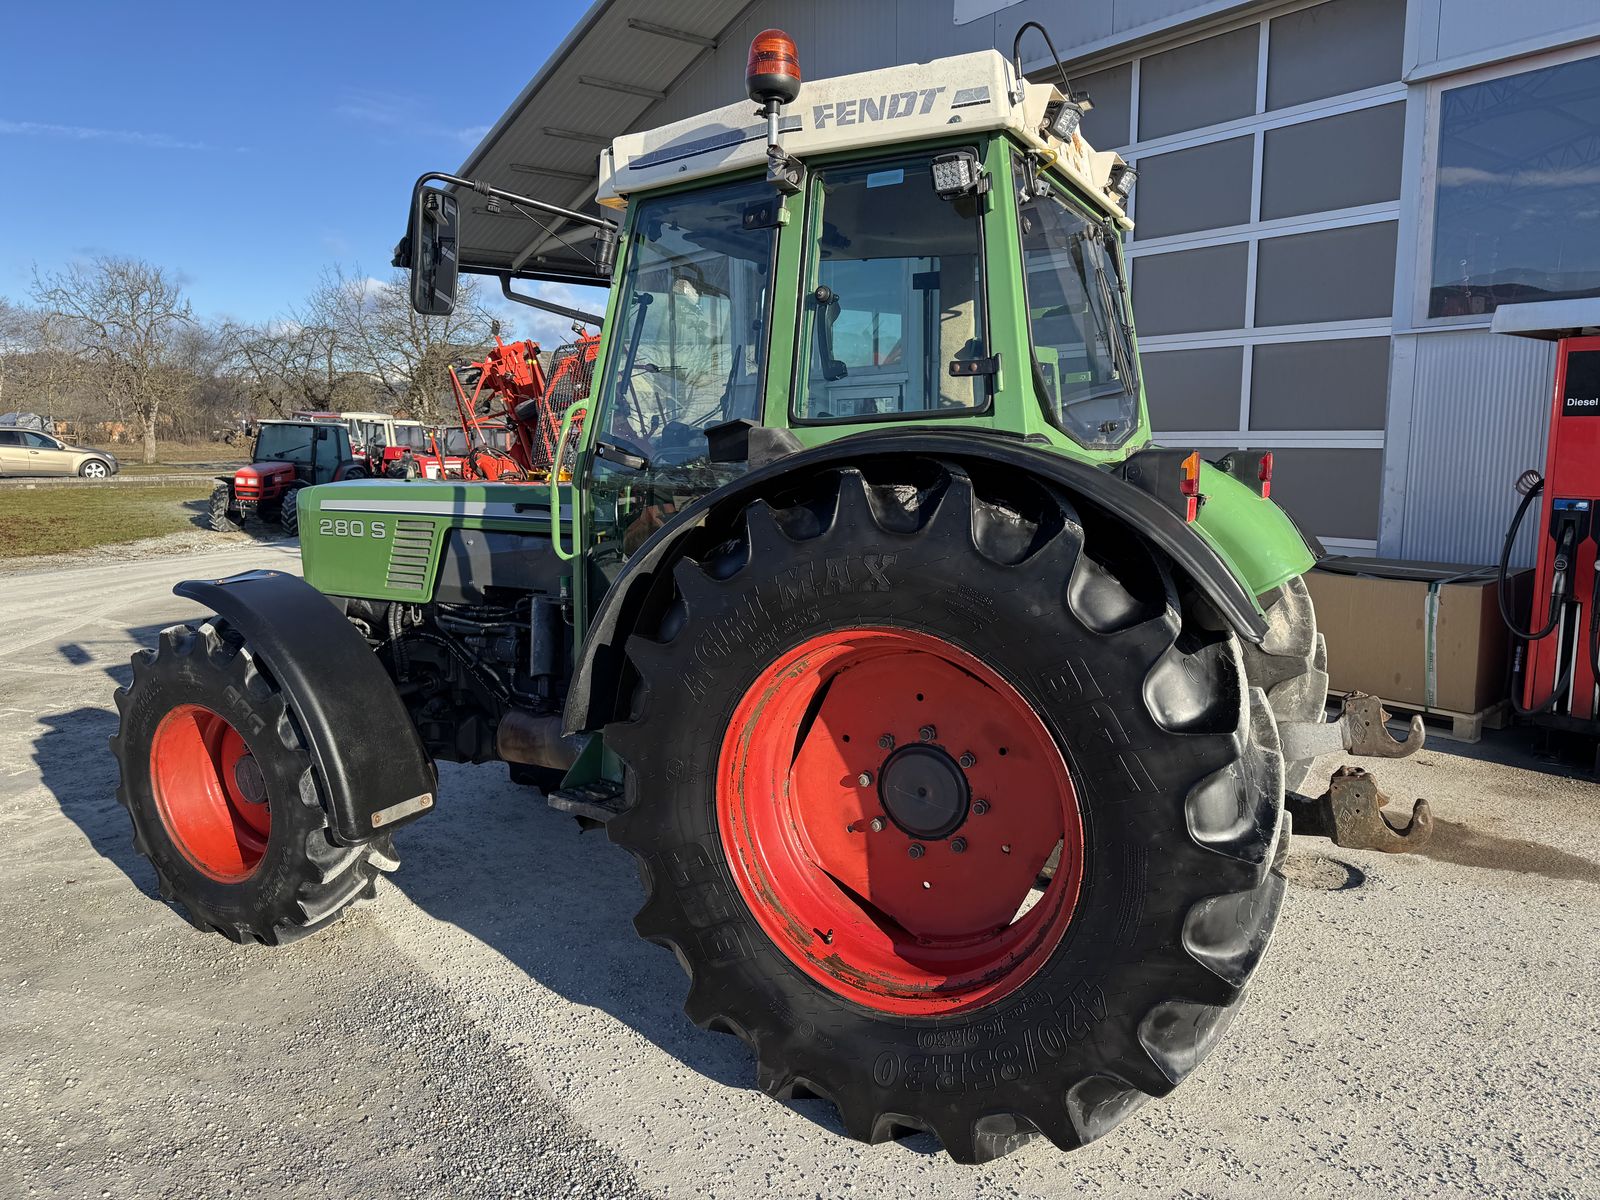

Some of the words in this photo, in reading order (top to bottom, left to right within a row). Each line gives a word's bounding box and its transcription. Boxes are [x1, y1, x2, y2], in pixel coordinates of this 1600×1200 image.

[812, 86, 946, 130] FENDT
[1567, 397, 1599, 406] Diesel
[319, 518, 365, 537] 280
[371, 521, 386, 539] S
